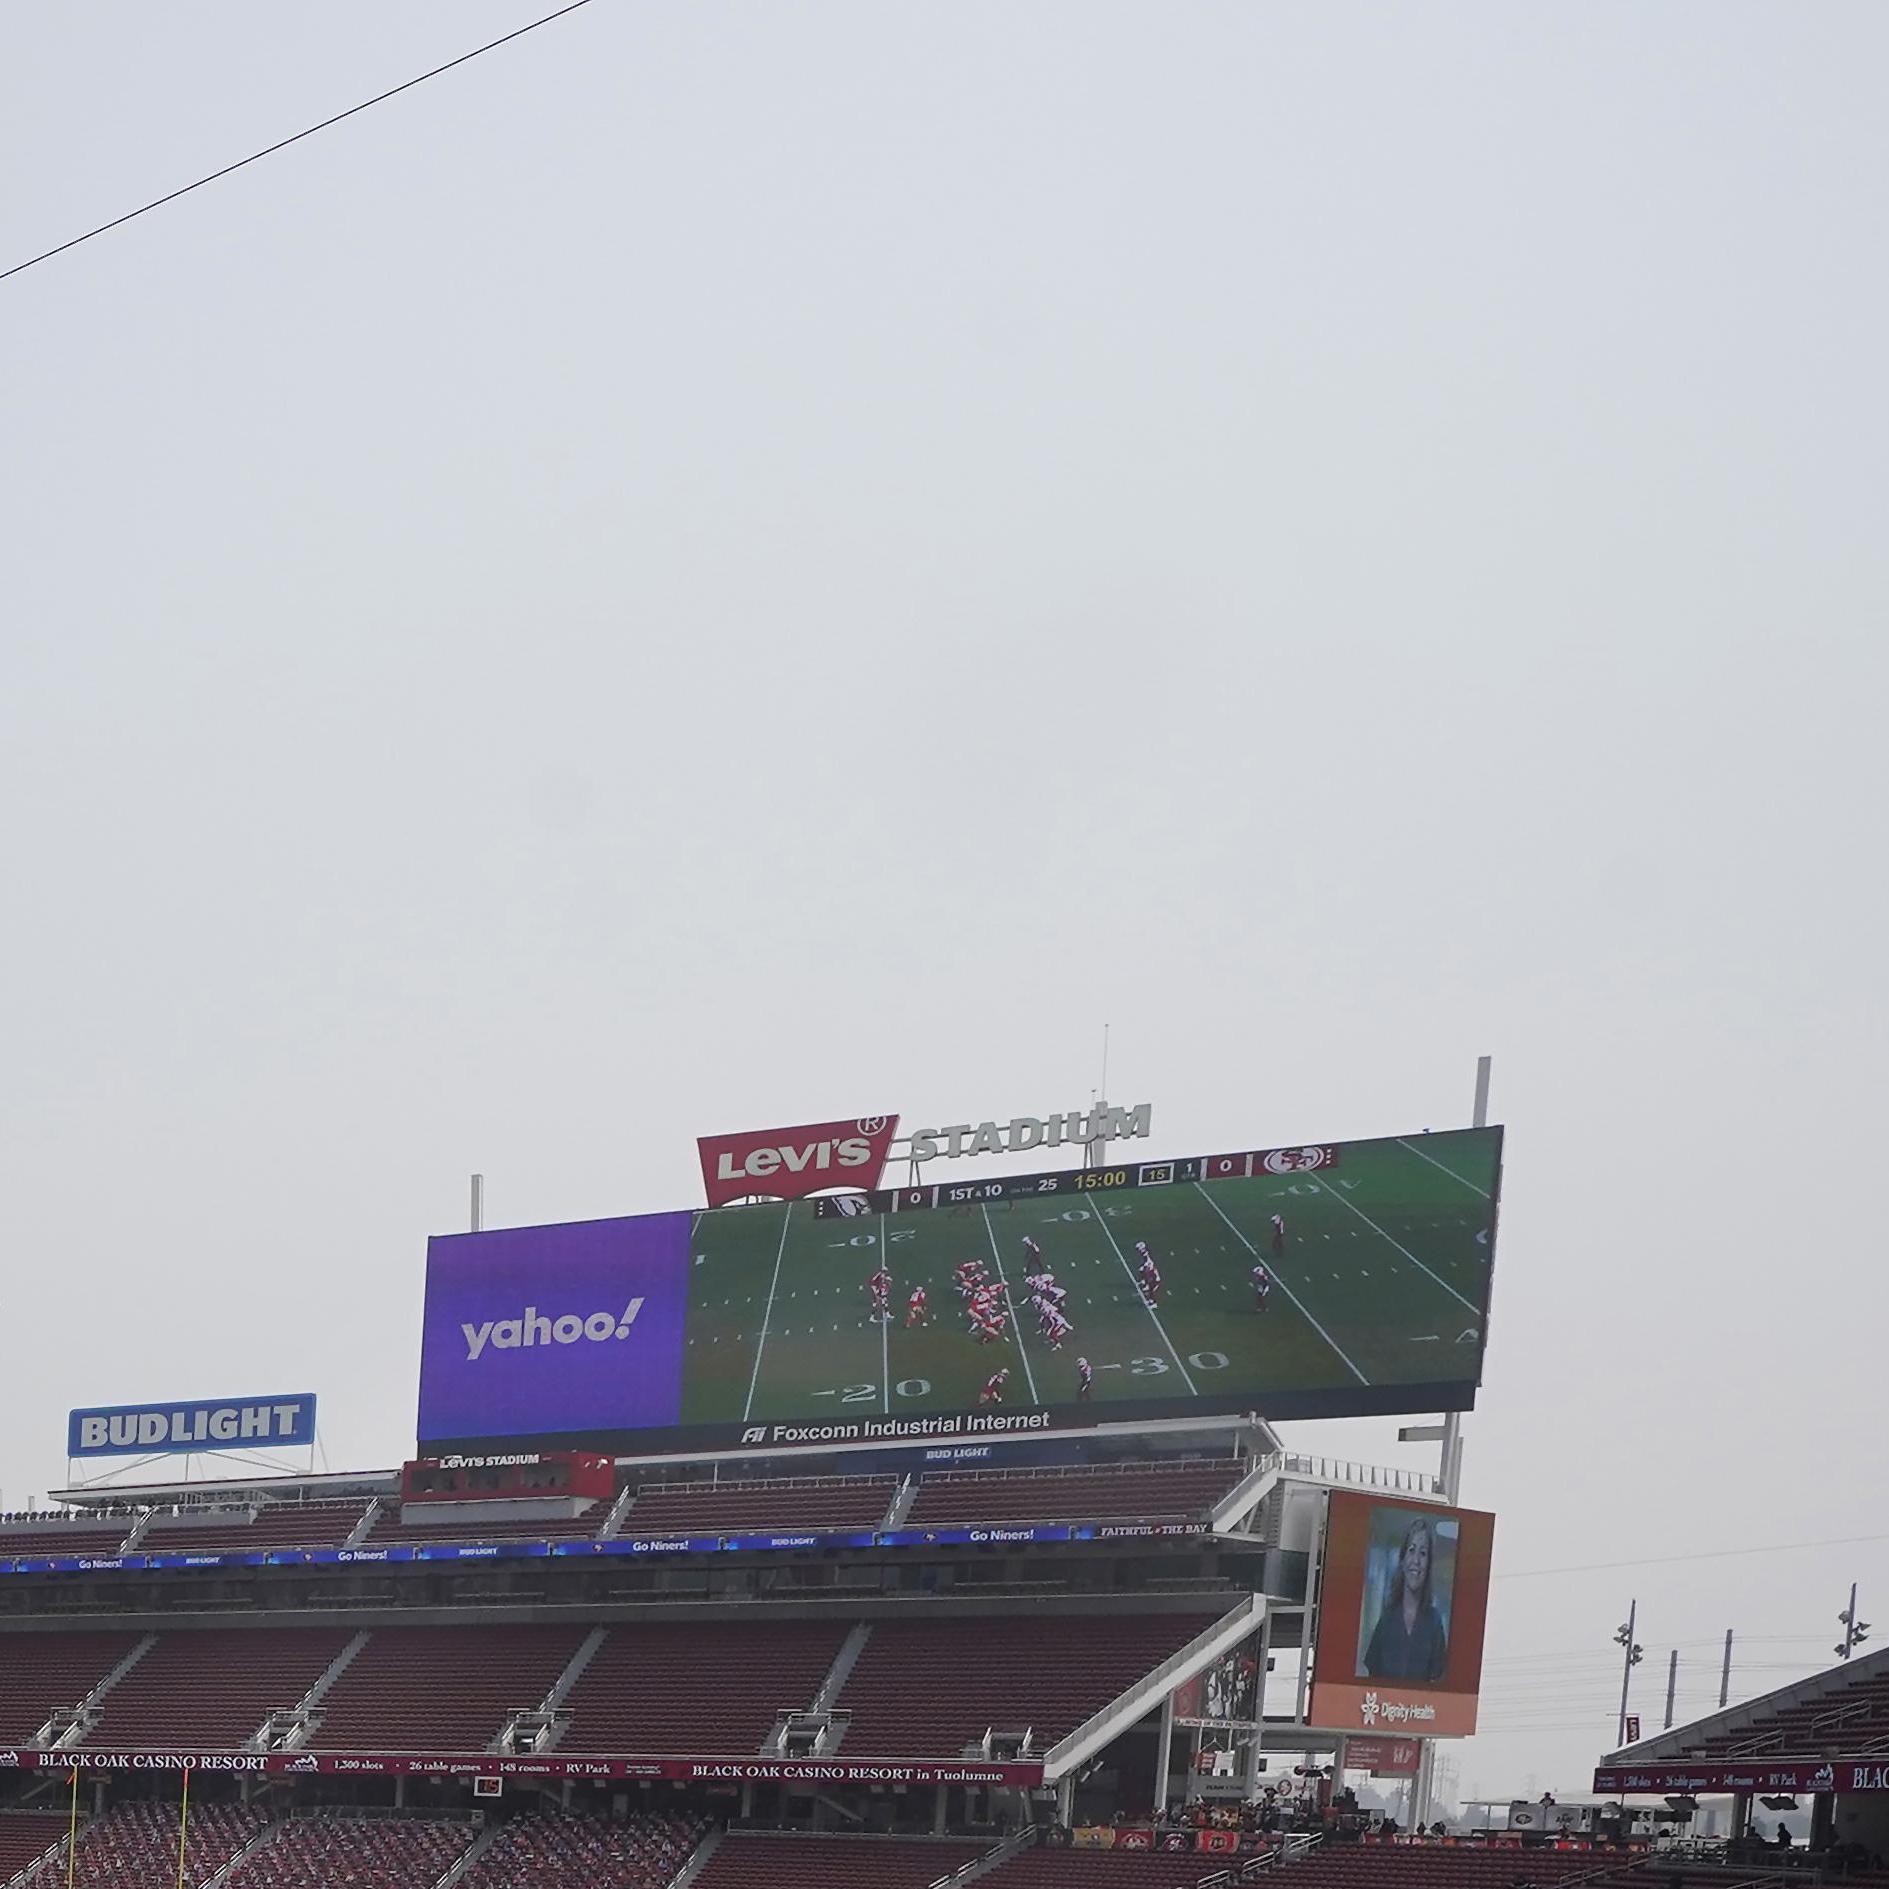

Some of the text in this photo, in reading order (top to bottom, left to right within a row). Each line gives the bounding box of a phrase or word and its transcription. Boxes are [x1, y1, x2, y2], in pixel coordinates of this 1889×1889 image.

[909, 1104, 1151, 1162] STADIUM
[1075, 1171, 1126, 1189] 15:00
[1147, 1168, 1166, 1182] 15
[949, 1188, 975, 1202] 1ST
[984, 1184, 1003, 1198] 10
[1038, 1177, 1058, 1192] 25
[461, 1297, 645, 1361] yahoo!
[80, 1404, 299, 1449] BUD LIGHT
[773, 1409, 1050, 1443] Foxconn Industrial Internet
[485, 1454, 539, 1466] STADIUM
[927, 1447, 990, 1459] BUD LIGHT
[970, 1530, 1033, 1540] Go Niners!
[1102, 1526, 1153, 1537] FAITHFUL
[651, 1540, 688, 1550] Niners!
[354, 1550, 387, 1561] Niners!
[1381, 1703, 1435, 1722] Dignity Health
[39, 1753, 268, 1770] BLACK OAK CASINO RESORT
[585, 1763, 610, 1775] Park
[692, 1765, 1003, 1782] BLACK OAK CASINO RESORT in Tuolumne
